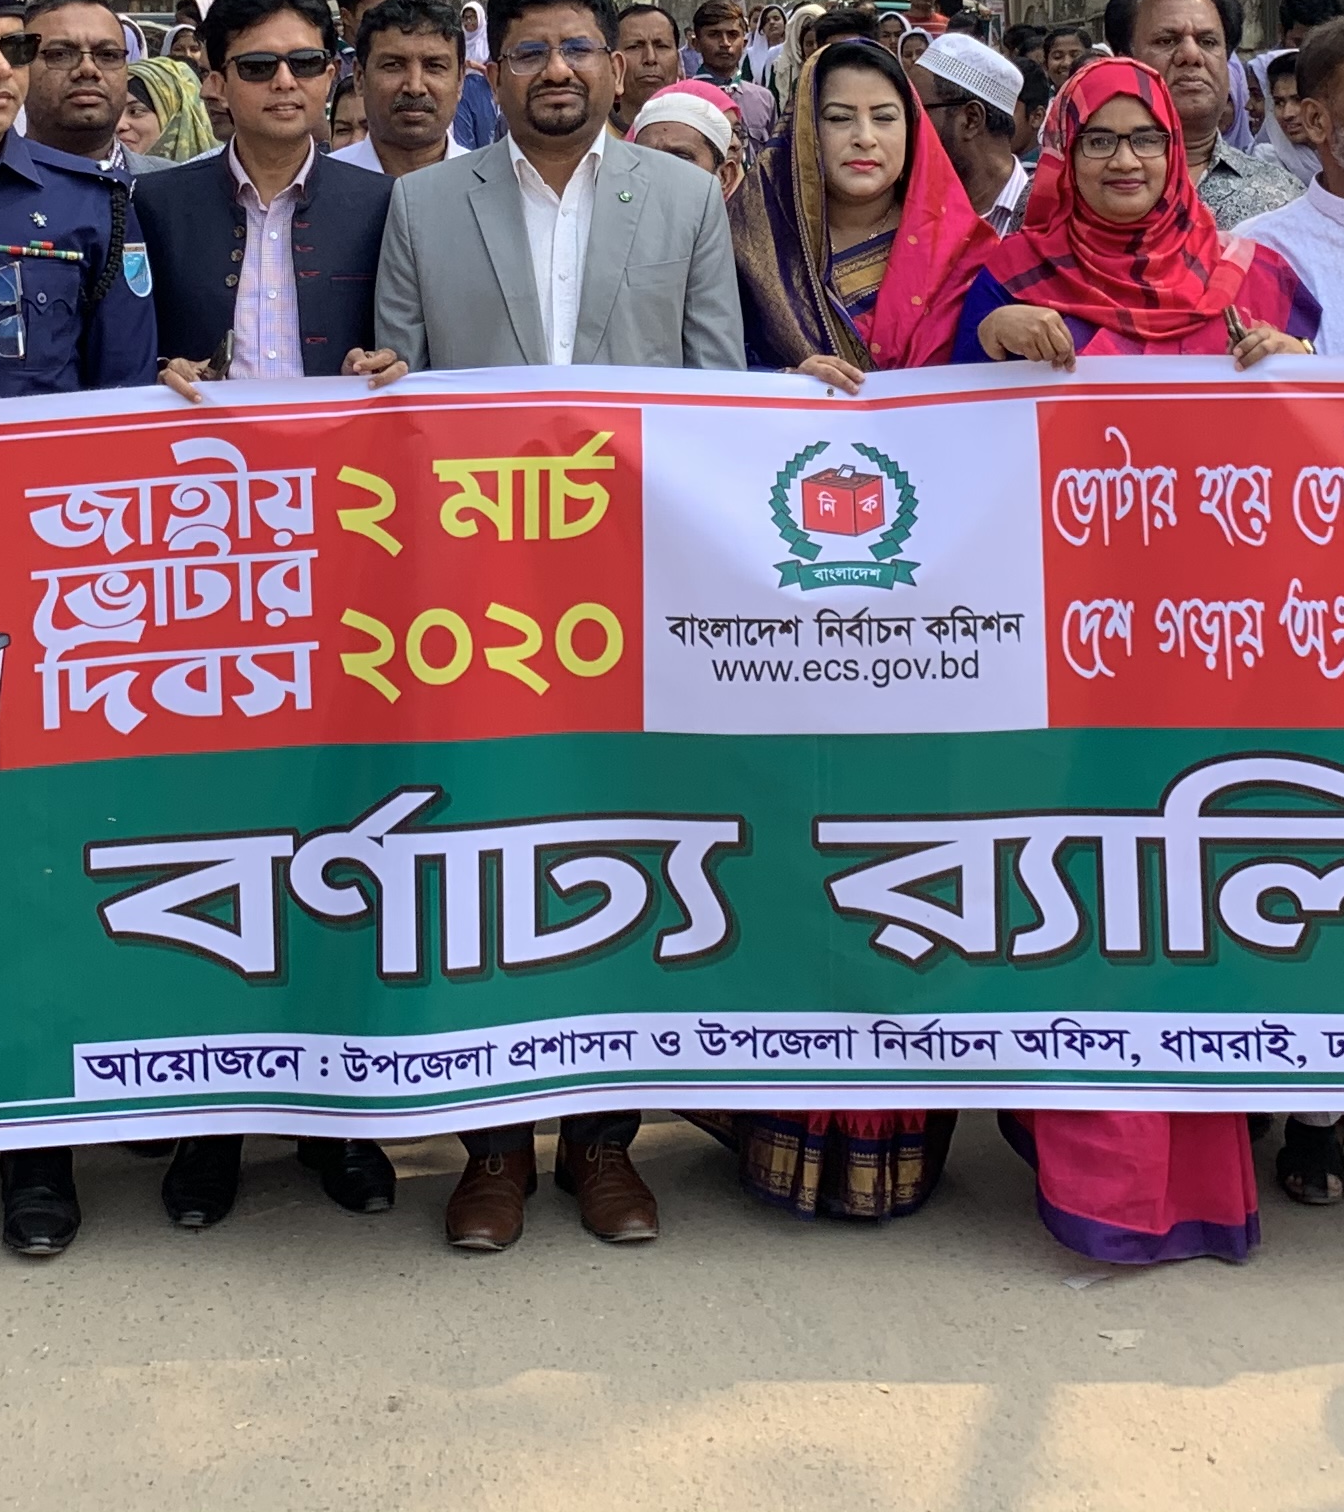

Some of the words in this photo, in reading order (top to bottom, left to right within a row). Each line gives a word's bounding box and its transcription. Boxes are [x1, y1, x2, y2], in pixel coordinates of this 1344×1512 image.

[25, 436, 315, 555] জাতীয়
[336, 464, 403, 558] ২
[432, 430, 617, 542] মার্চ
[1053, 426, 1178, 546] ভোটার
[1195, 463, 1272, 546] হয়ে
[30, 525, 317, 651] ভোটার
[665, 611, 803, 649] বাংলাদেশ
[813, 606, 916, 647] নির্বাচন
[921, 605, 1025, 645] কমিশন
[812, 566, 882, 584] বাংলাদেশ
[34, 623, 319, 735] দিবস
[338, 601, 625, 704] ২০২০
[712, 651, 980, 688] www.ecs.gov.bd
[1062, 598, 1134, 679] দেশ
[1155, 597, 1264, 679] গড়ায়
[84, 785, 748, 984] বর্ণাঢ্য
[82, 1043, 305, 1088] আয়োজনে
[340, 1040, 495, 1086] উপজেলা
[509, 1028, 636, 1071] প্রশাসন
[653, 1031, 681, 1055] ও
[698, 1020, 857, 1066] উপজেলা
[869, 1018, 1002, 1063] নির্বাচন
[1014, 1017, 1142, 1068] অফিস,
[1159, 1020, 1307, 1068] ধামরাই,
